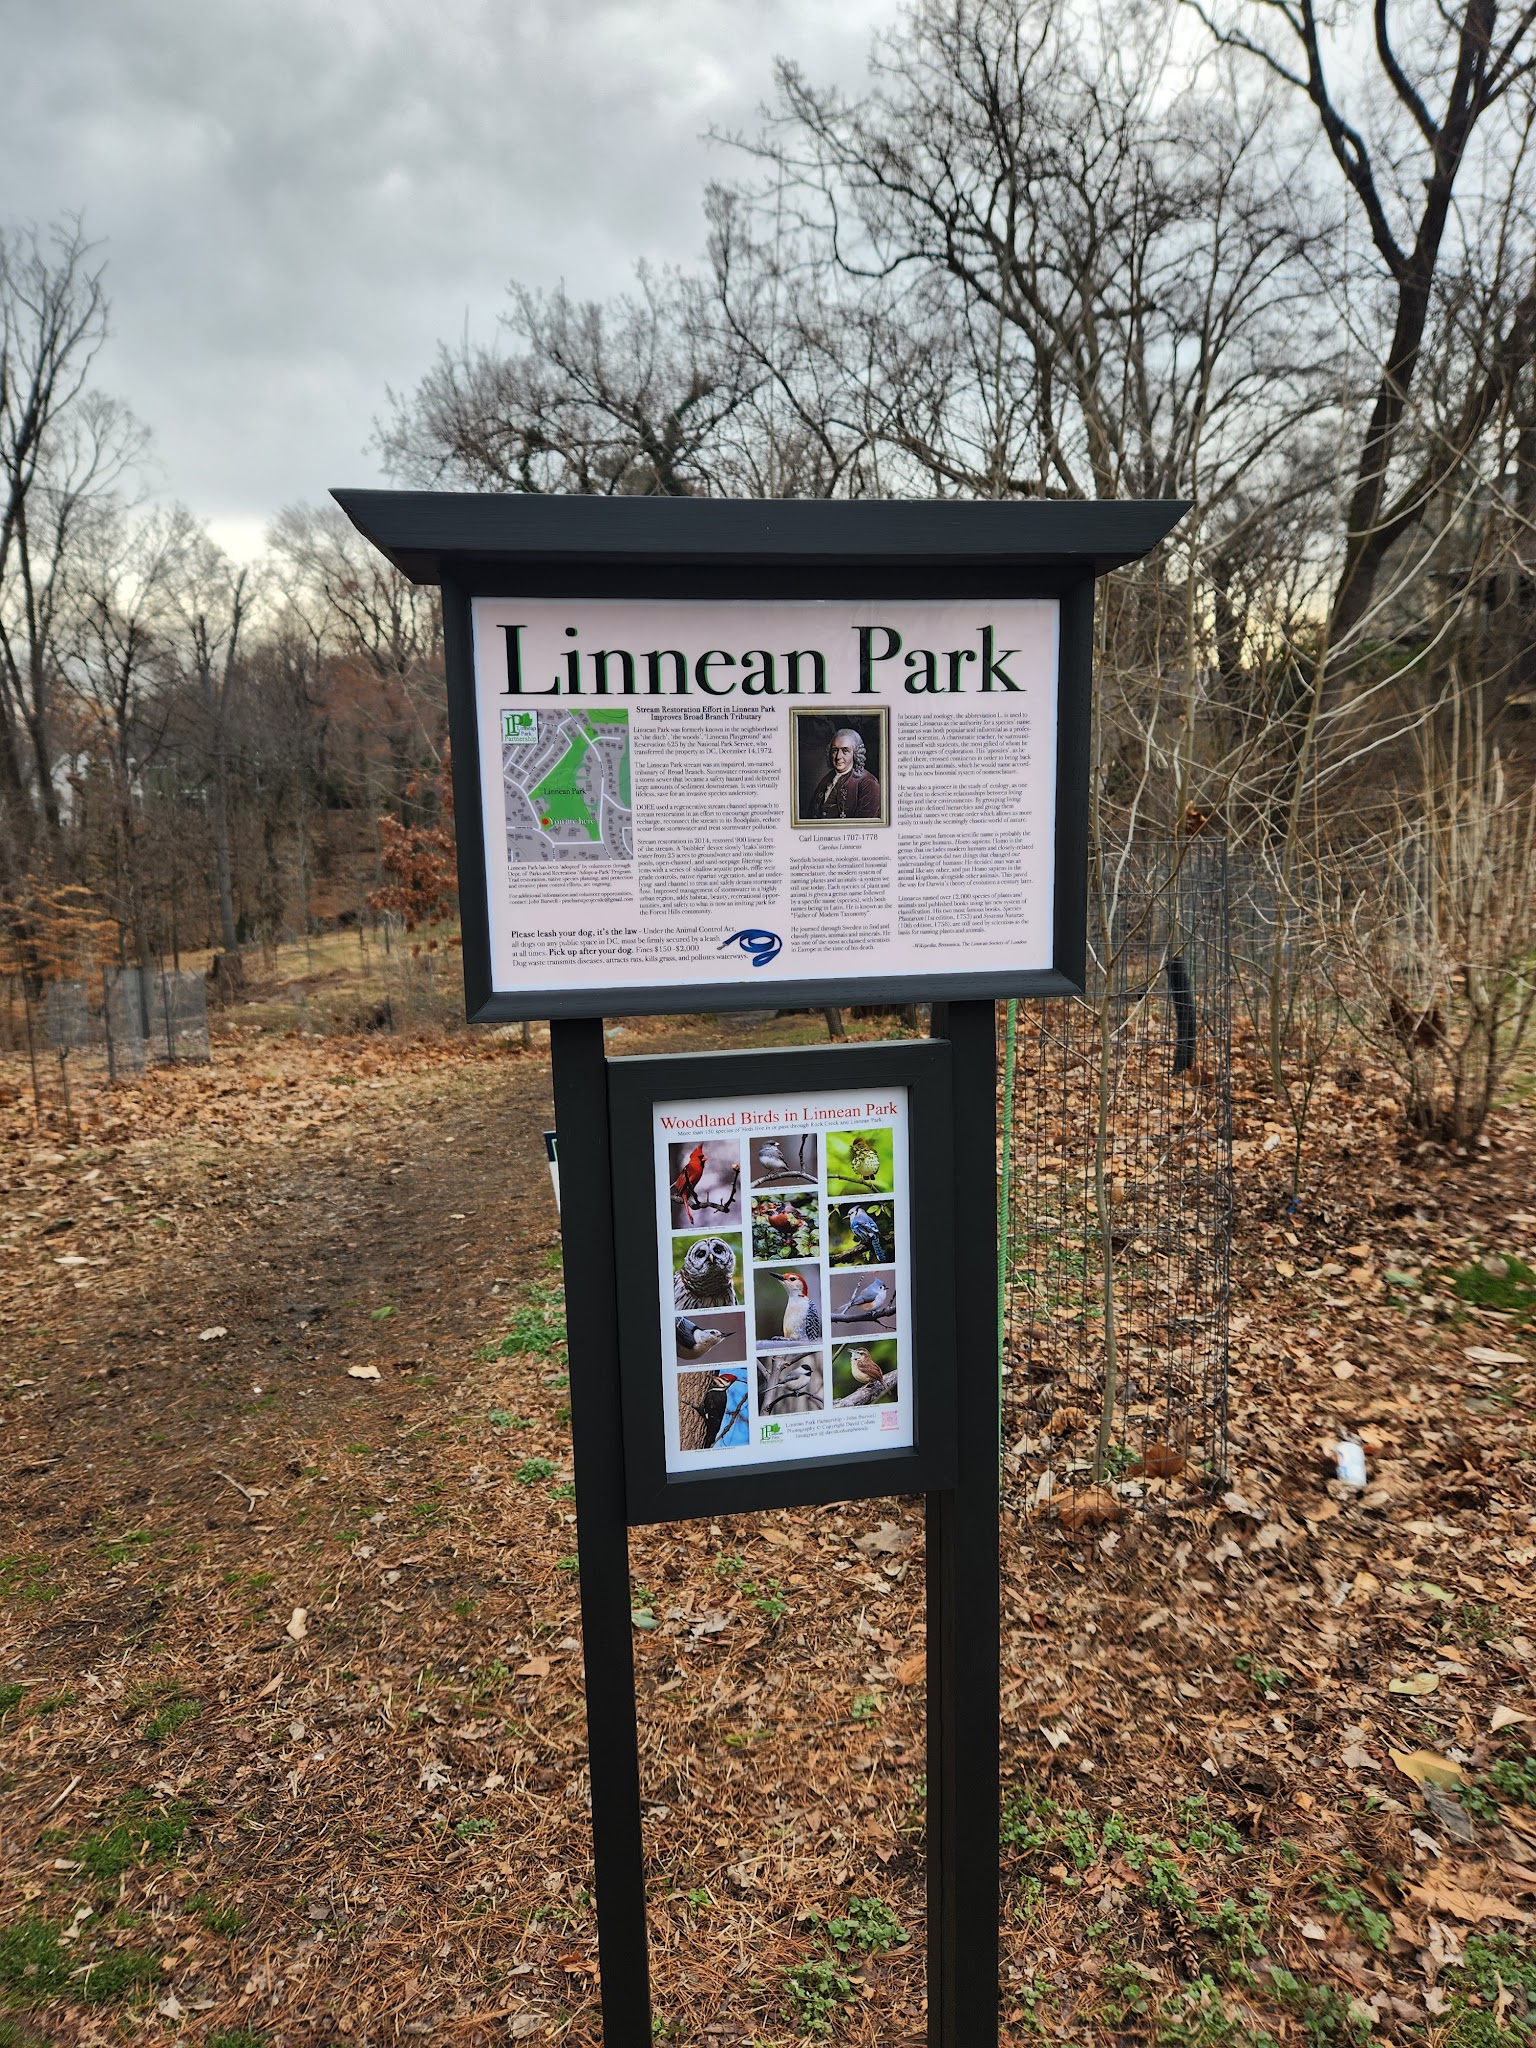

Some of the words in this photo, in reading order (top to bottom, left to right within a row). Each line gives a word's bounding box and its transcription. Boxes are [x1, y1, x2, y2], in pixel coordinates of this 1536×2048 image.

[496, 624, 832, 697] Linnean
[851, 624, 1027, 695] Park
[636, 705, 660, 713] Stream
[661, 705, 701, 713] Restoration
[702, 705, 722, 713] Effort
[732, 705, 759, 713] Linnean
[760, 705, 776, 713] Park
[651, 713, 682, 723] Improves
[683, 713, 704, 721] Broad
[729, 712, 762, 722] Tributary
[904, 713, 922, 721] botany
[681, 726, 704, 734] formerly
[740, 725, 779, 734] neighborhood
[504, 735, 537, 743] Partnership
[543, 787, 571, 795] Linnean
[571, 787, 587, 795] Park
[549, 817, 565, 825] You
[578, 817, 595, 825] here
[813, 834, 841, 842] Linnaeus
[843, 833, 878, 841] 1707-1778
[511, 930, 536, 938] Please
[537, 929, 557, 938] leash
[558, 931, 576, 939] your
[577, 928, 595, 938] dog,
[624, 927, 638, 935] law
[664, 926, 674, 934] the
[675, 926, 698, 934] Animal
[698, 925, 723, 933] Control
[723, 925, 737, 933] Act,
[511, 940, 519, 948] all
[520, 940, 536, 949] dogs
[558, 939, 579, 948] public
[646, 936, 665, 945] firmly
[666, 935, 690, 943] secured
[691, 935, 699, 944] by
[704, 934, 721, 942] leash
[518, 949, 527, 957] all
[528, 949, 547, 957] times.
[549, 948, 566, 956] Pick
[579, 947, 597, 955] after
[598, 949, 616, 957] your
[617, 946, 634, 956] dog.
[635, 945, 653, 953] Fines
[654, 945, 672, 953] $150
[512, 959, 527, 968] Dog
[690, 953, 716, 962] pollutes
[660, 1112, 736, 1130] Woodland
[741, 1109, 780, 1125] Birds
[784, 1109, 798, 1122] in
[803, 1104, 861, 1120] Linnean
[866, 1101, 898, 1116] Park
